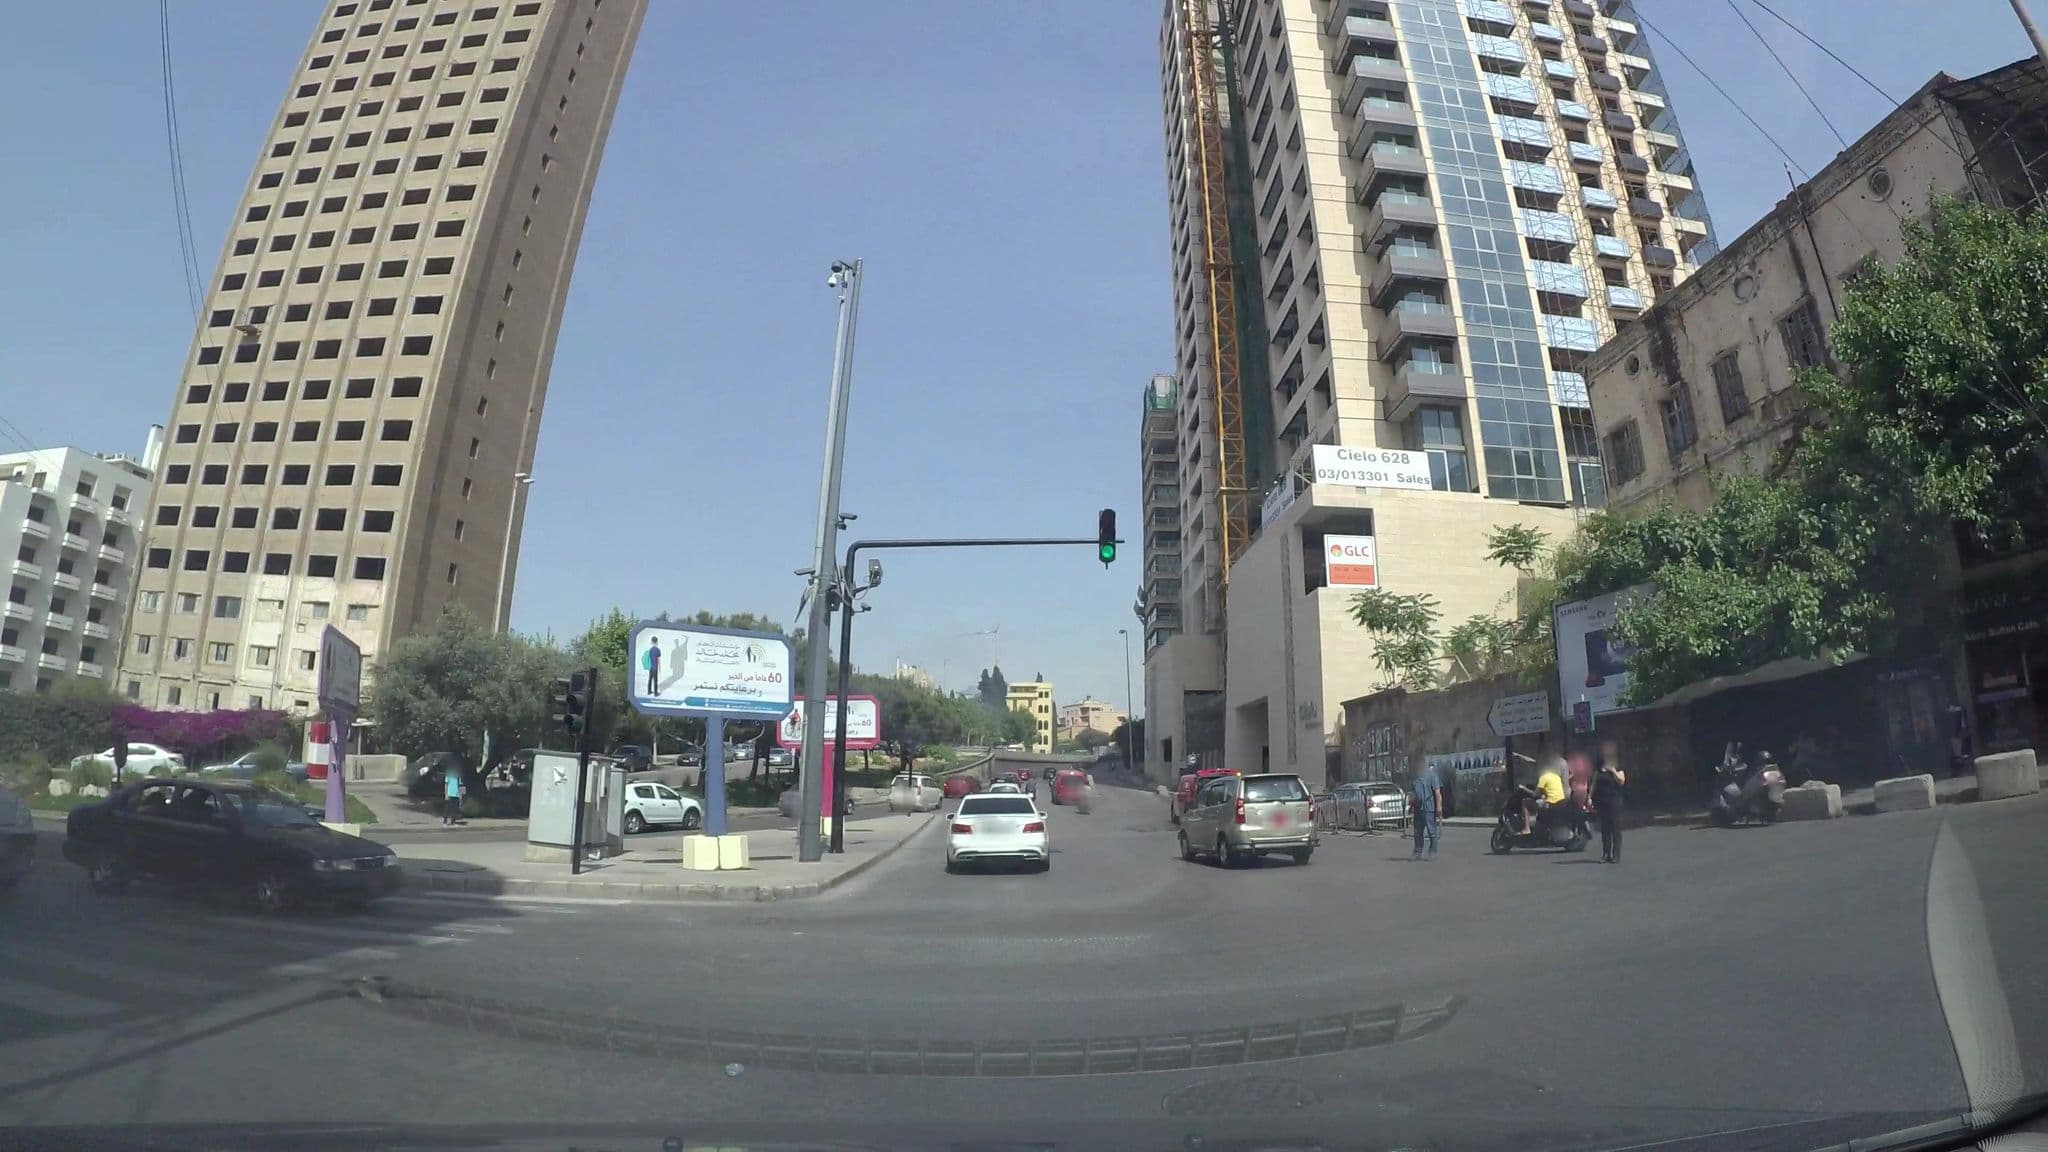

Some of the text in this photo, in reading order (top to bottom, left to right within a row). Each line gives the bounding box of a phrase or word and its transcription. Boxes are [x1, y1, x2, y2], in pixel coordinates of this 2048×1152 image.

[1337, 449, 1410, 465] Cielo 628
[1318, 469, 1430, 485] 03/013301 Sales
[1344, 545, 1370, 557] GLC
[768, 672, 782, 683] 60
